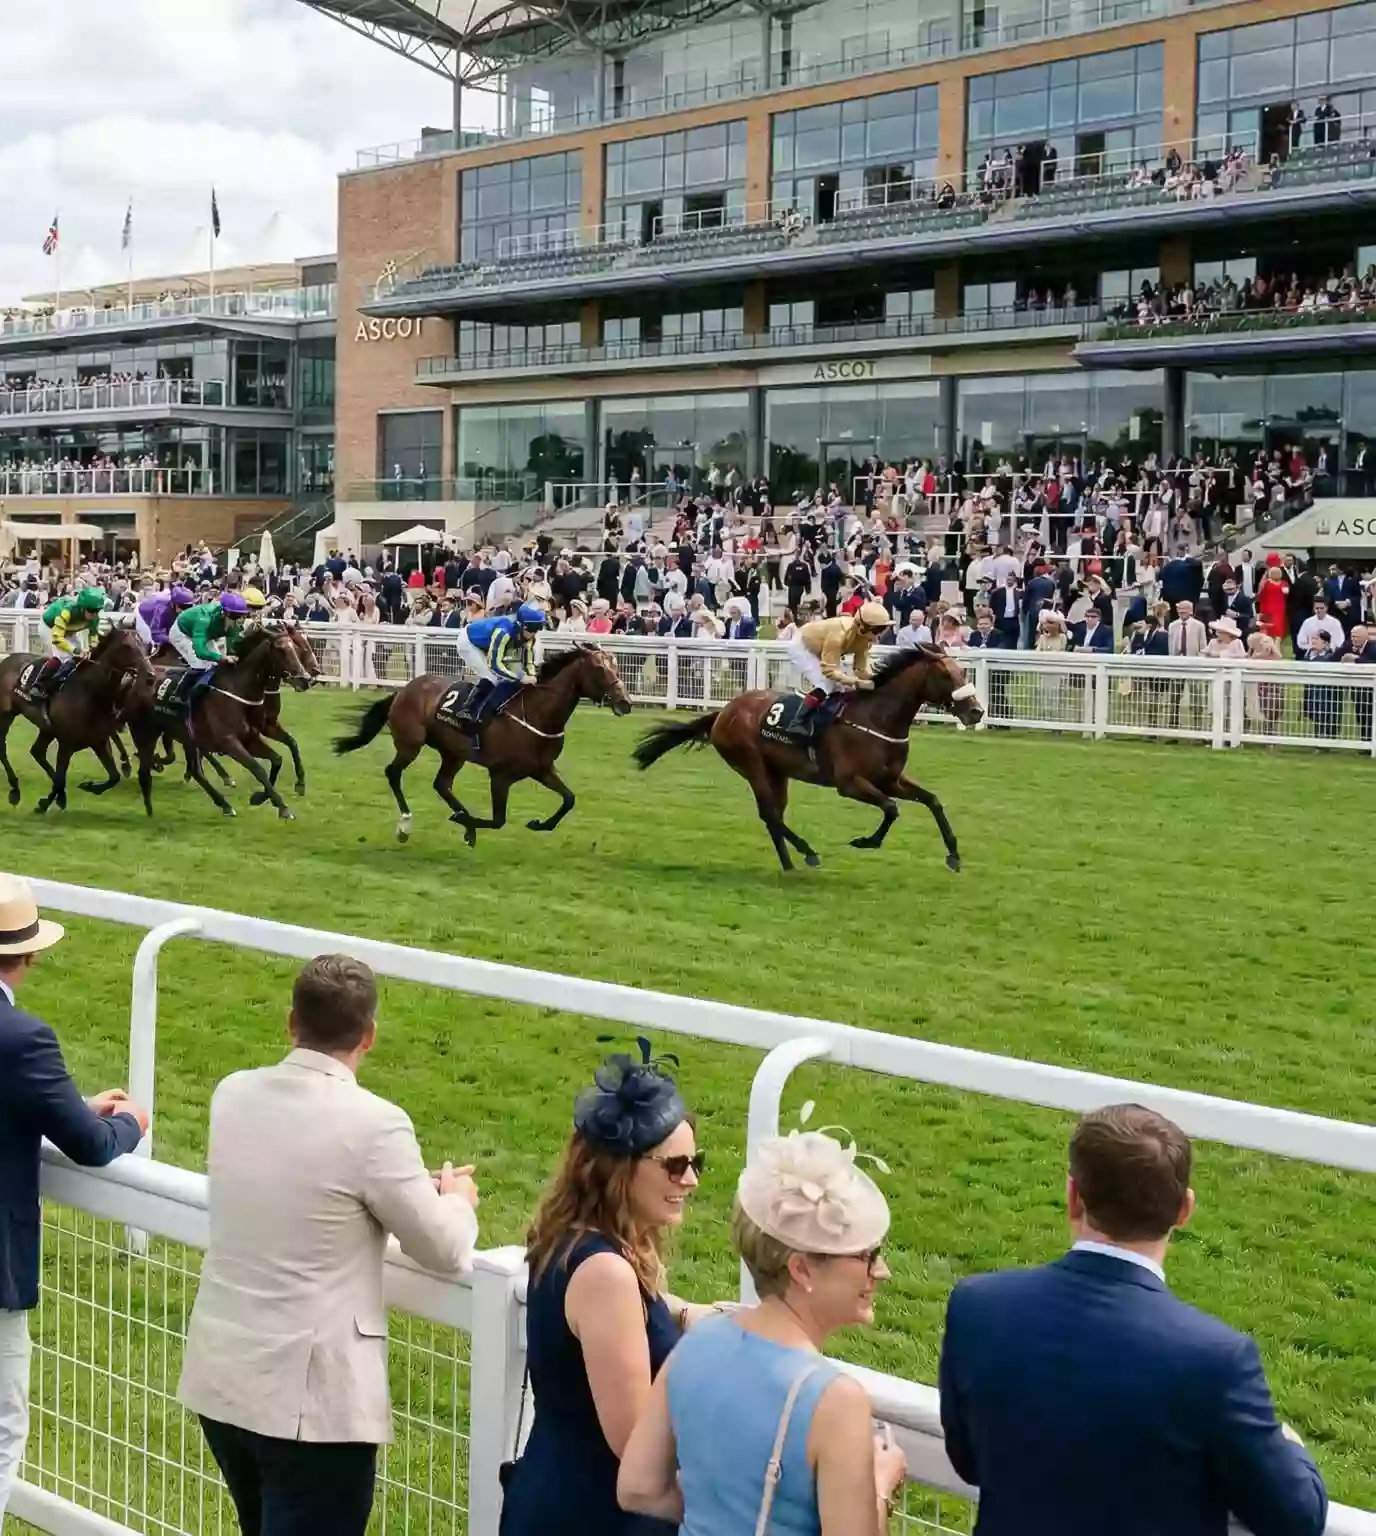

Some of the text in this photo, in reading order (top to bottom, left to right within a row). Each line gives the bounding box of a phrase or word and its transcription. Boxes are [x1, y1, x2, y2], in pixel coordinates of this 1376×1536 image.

[814, 360, 877, 380] ASCOT
[440, 690, 459, 713] 2
[766, 702, 785, 726] 3
